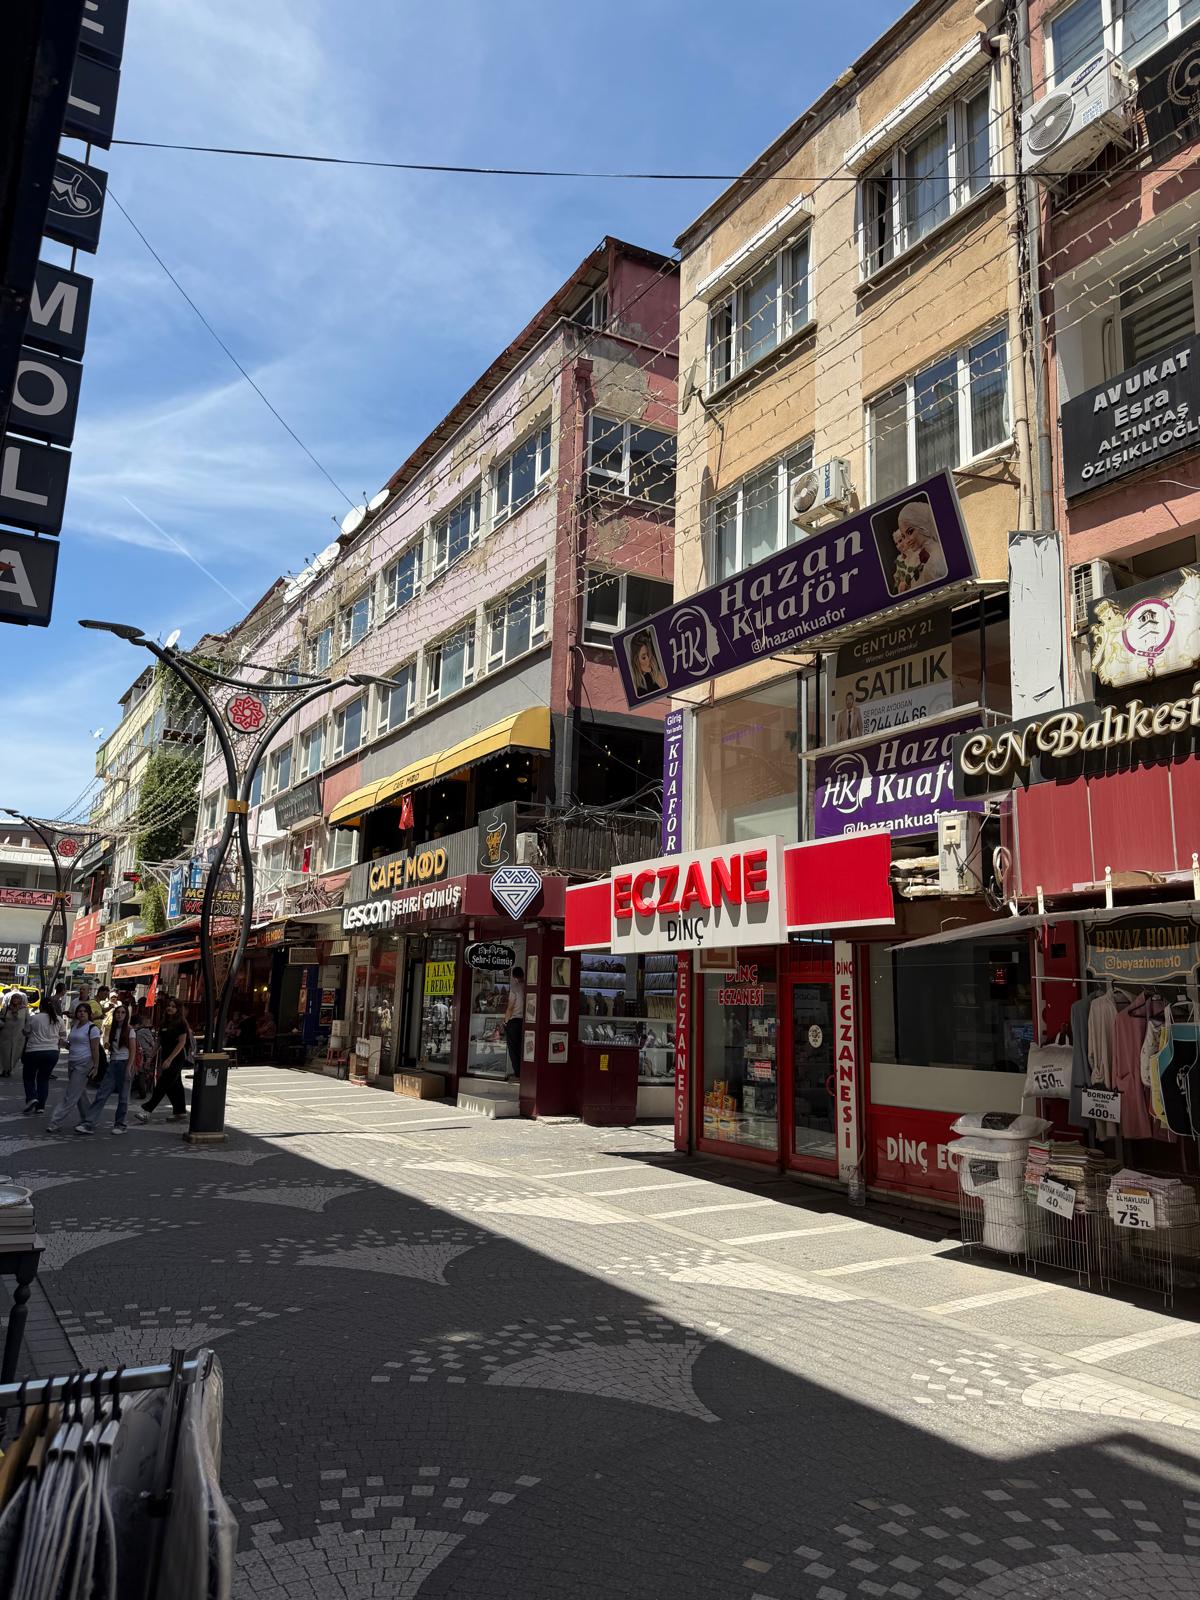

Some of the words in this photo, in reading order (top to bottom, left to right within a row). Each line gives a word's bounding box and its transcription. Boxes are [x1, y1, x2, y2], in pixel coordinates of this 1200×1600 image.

[1093, 348, 1192, 414] AVUKAT
[1097, 402, 1190, 455] ALTINTAŞ
[1113, 389, 1170, 428] Esra
[1081, 416, 1200, 480] ÖZIŞIKLIOĞL
[719, 530, 864, 618] Hazan
[731, 567, 860, 642] Kuaför
[853, 624, 917, 658] CENTURY
[854, 651, 948, 703] SATILIK
[666, 743, 680, 851] KUAFÖR
[875, 760, 954, 806] Kuaf
[368, 859, 403, 892] CAFE
[405, 847, 447, 883] MOOD
[613, 848, 770, 920] ECZANE
[423, 884, 461, 909] GÜMÜŞ
[667, 914, 704, 946] DİNÇ
[1095, 928, 1142, 953] BEYAZ
[1146, 926, 1190, 952] HOME
[717, 984, 765, 1006] ECZANESİ
[676, 972, 688, 1137] ECZANESİ
[838, 984, 855, 1149] ECZANESİ
[1034, 1073, 1056, 1090] 150
[1087, 1091, 1116, 1101] BORNOZ
[1088, 1107, 1109, 1119] 400
[886, 1132, 928, 1173] DİNÇ
[1046, 1196, 1059, 1208] 40
[1116, 1194, 1123, 1202] EL
[1126, 1204, 1138, 1212] 150
[1117, 1210, 1140, 1227] 75
[1139, 1219, 1151, 1228] TL
